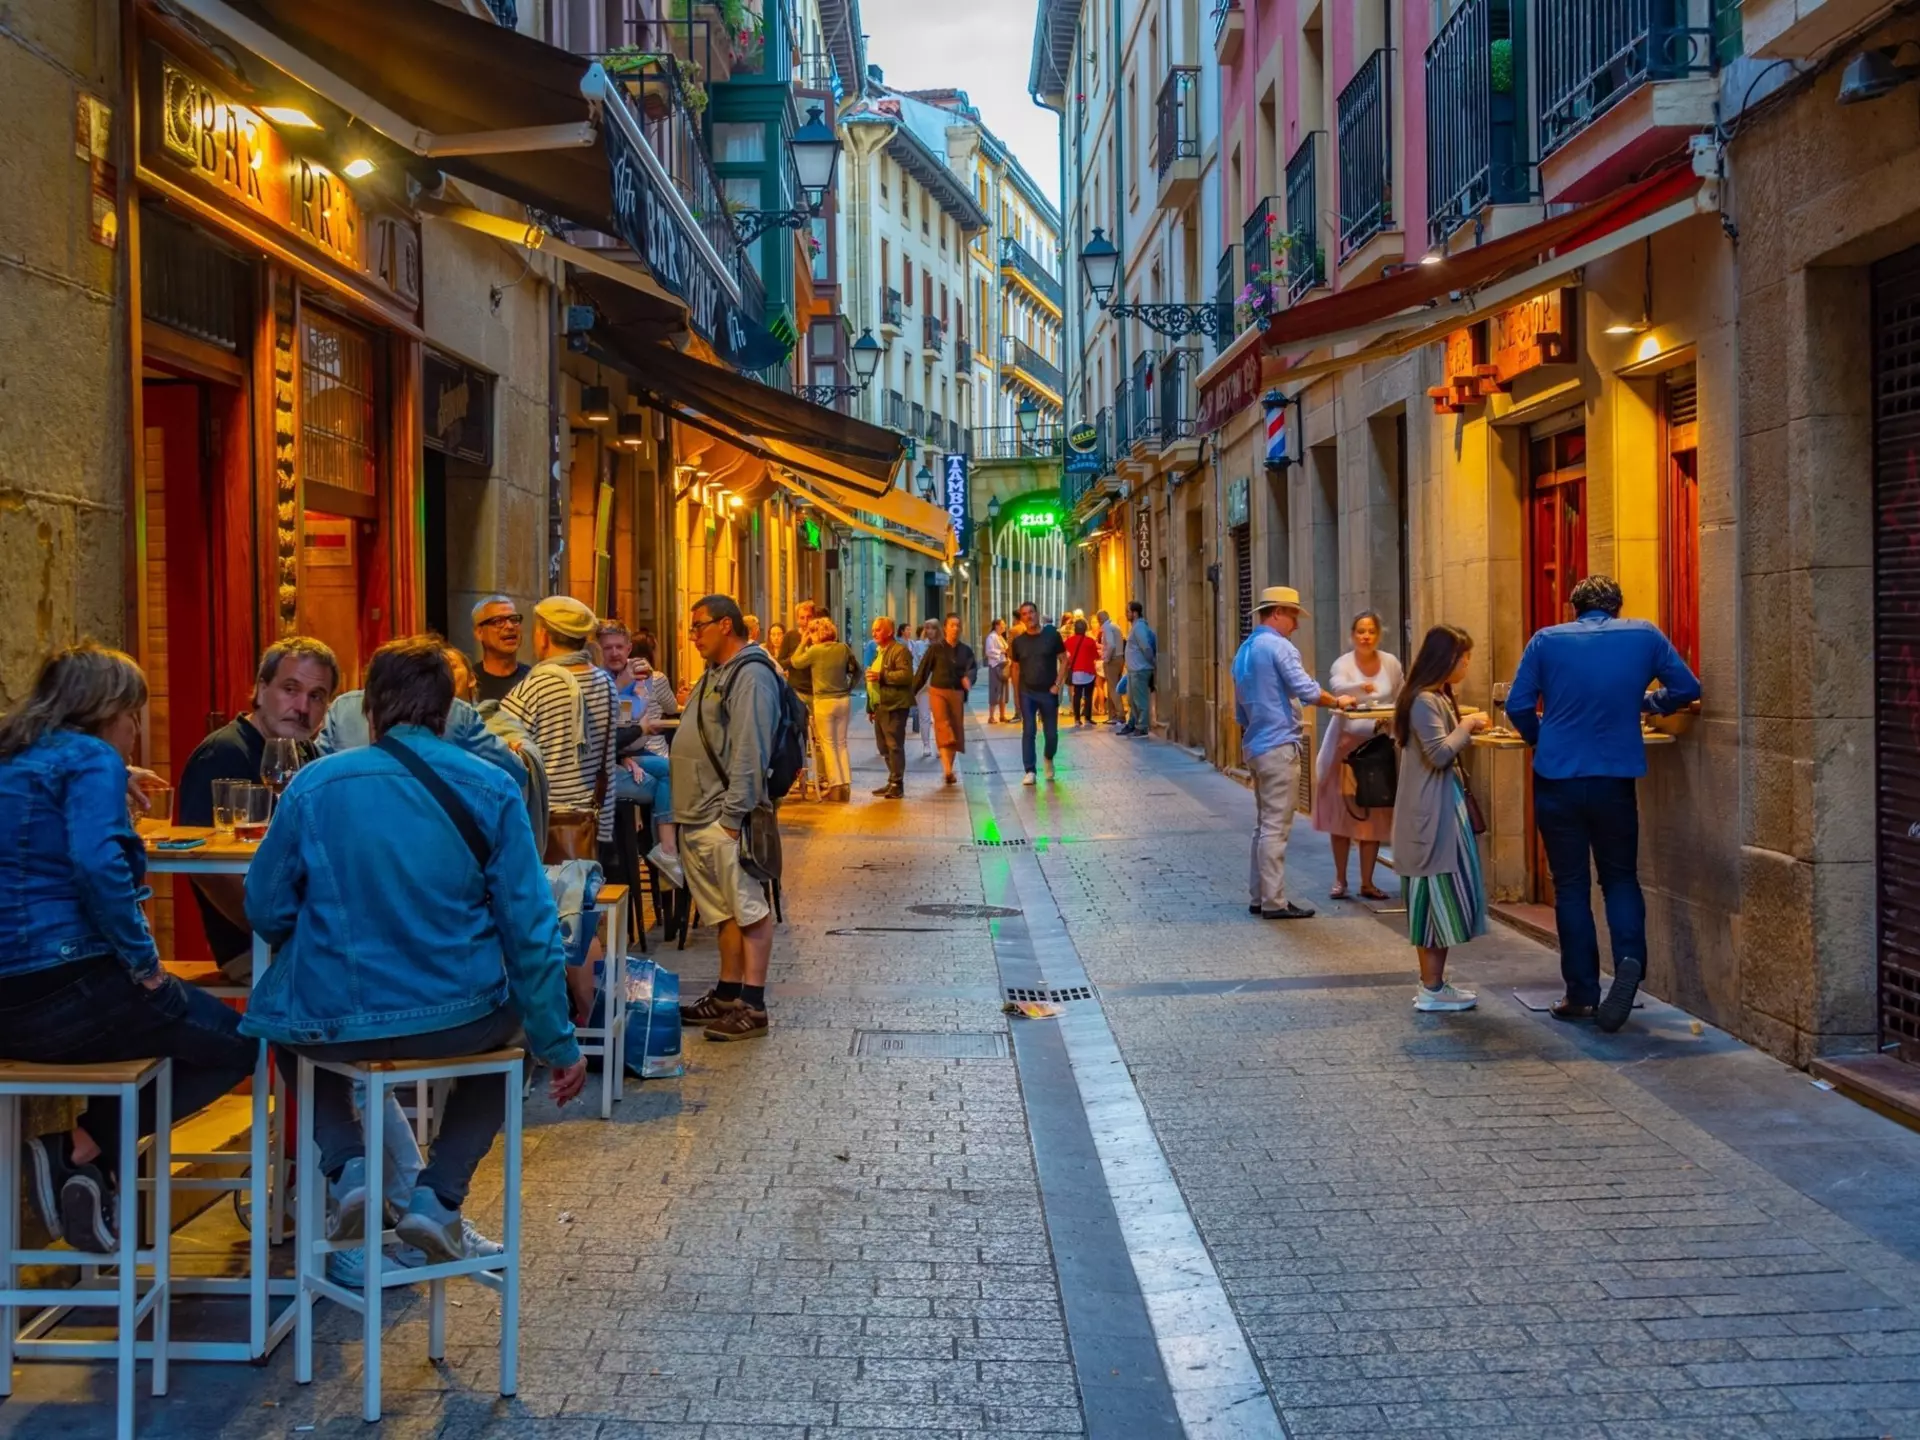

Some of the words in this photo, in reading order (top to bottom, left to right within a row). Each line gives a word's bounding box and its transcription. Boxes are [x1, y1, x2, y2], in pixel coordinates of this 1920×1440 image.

[200, 84, 264, 204] BAR
[646, 189, 682, 287] BAR
[946, 455, 965, 557] TAMBORI
[1139, 513, 1150, 568] TATTOO
